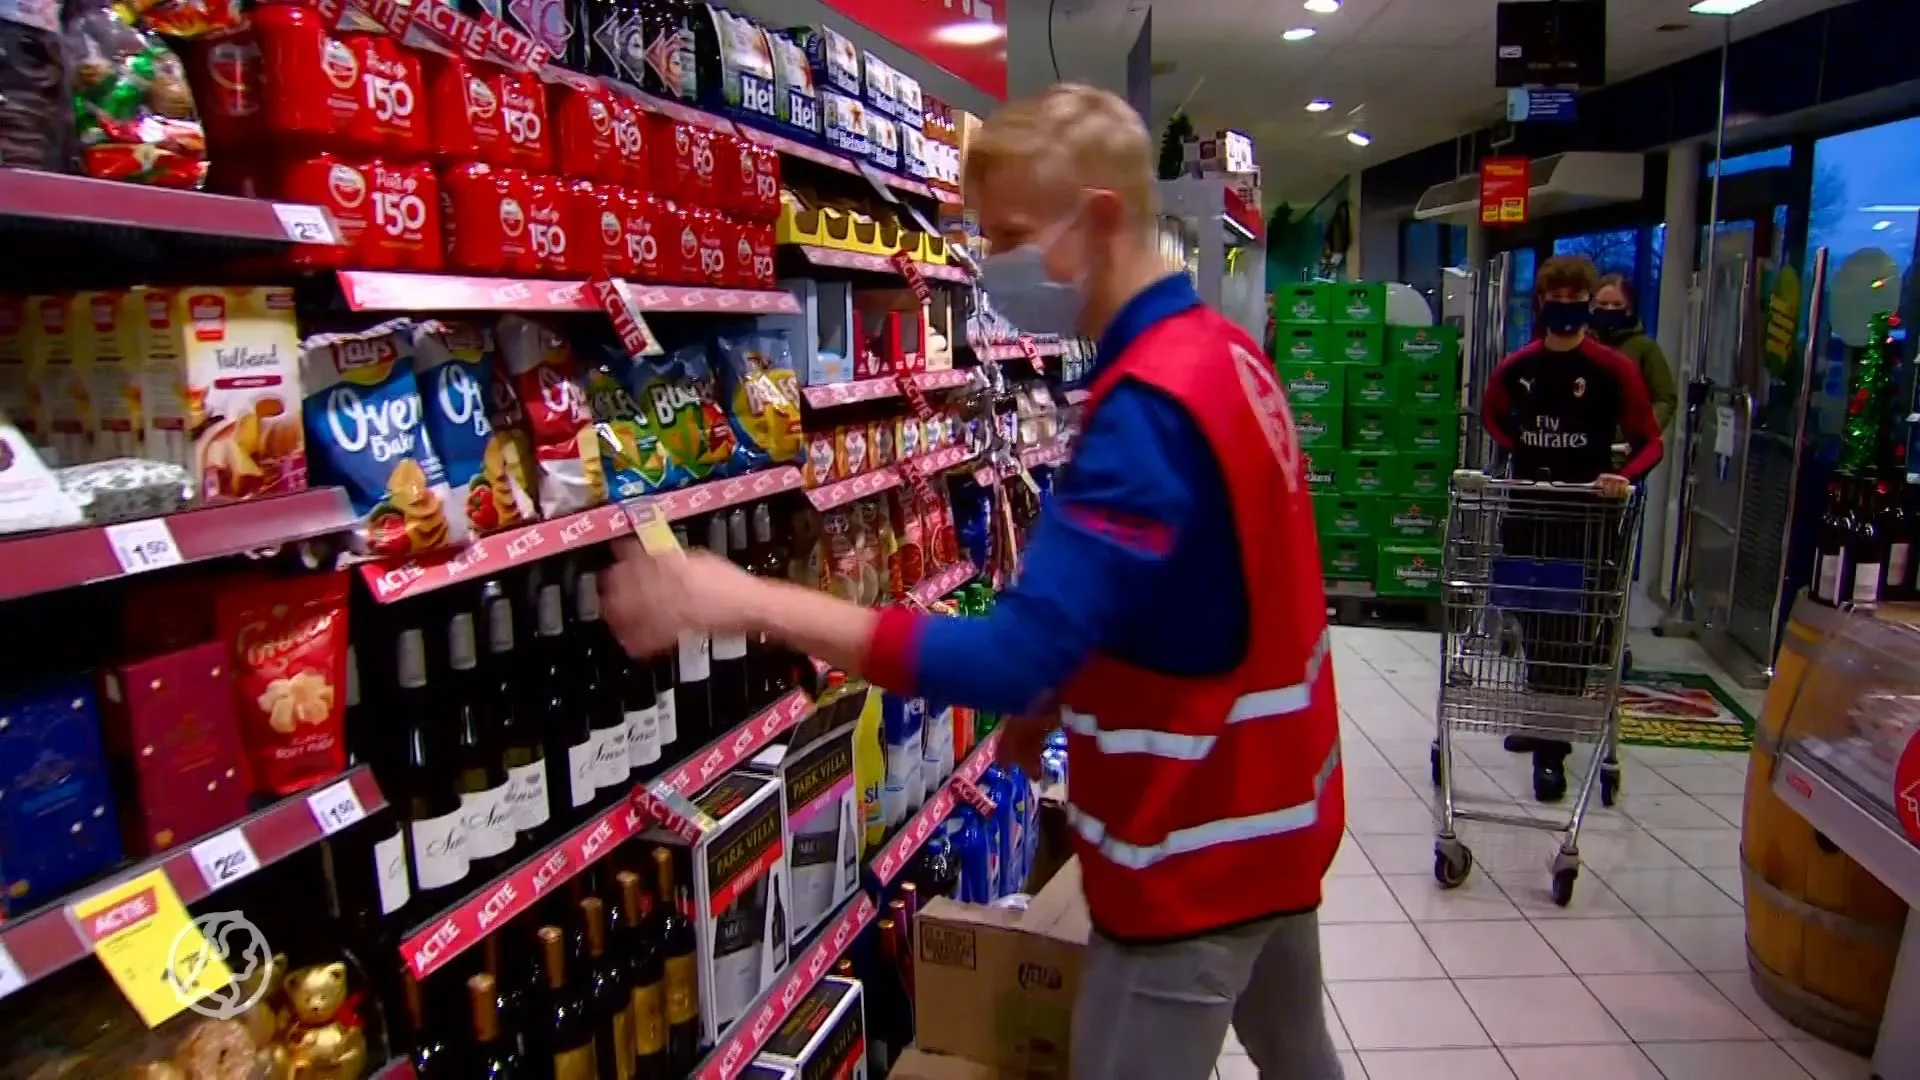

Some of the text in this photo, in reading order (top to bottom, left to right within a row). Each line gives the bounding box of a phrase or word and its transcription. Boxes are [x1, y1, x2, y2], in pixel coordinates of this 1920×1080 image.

[363, 73, 414, 120] 150
[742, 75, 775, 116] Hei
[790, 92, 817, 131] Hei
[501, 107, 541, 143] 150
[372, 191, 426, 236] 150
[528, 222, 566, 258] 150
[625, 233, 657, 264] 150
[700, 247, 724, 275] 150
[592, 281, 647, 352] ACTIE
[328, 387, 422, 451] Oven
[1536, 415, 1560, 431] Fly
[506, 528, 544, 559] ACTIE
[560, 516, 595, 544] ACTIE
[634, 791, 697, 842] ACTIE
[414, 917, 462, 973] ACTIE
[477, 879, 518, 929] ACTIE
[581, 819, 614, 860] ACTIE
